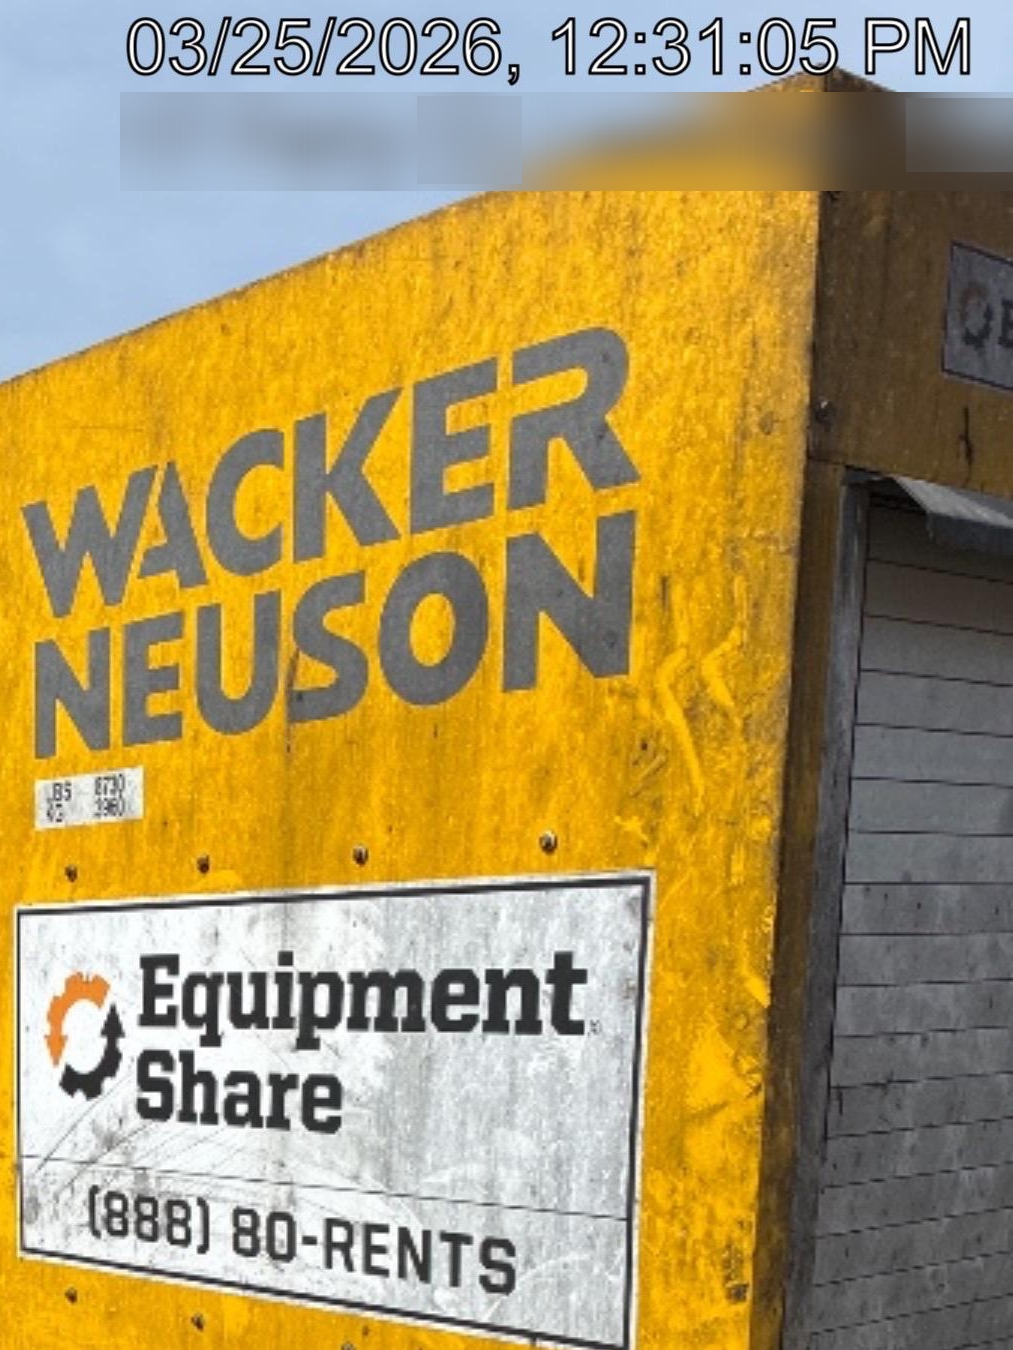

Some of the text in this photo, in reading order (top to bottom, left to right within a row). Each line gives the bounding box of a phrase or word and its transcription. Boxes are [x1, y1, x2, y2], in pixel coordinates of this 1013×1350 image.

[22, 326, 640, 618] WACKER
[35, 509, 638, 759] NEUSON
[139, 951, 588, 1050] Equipment
[136, 1050, 343, 1134] Share
[88, 1186, 517, 1295] (888) 80-RENTS
